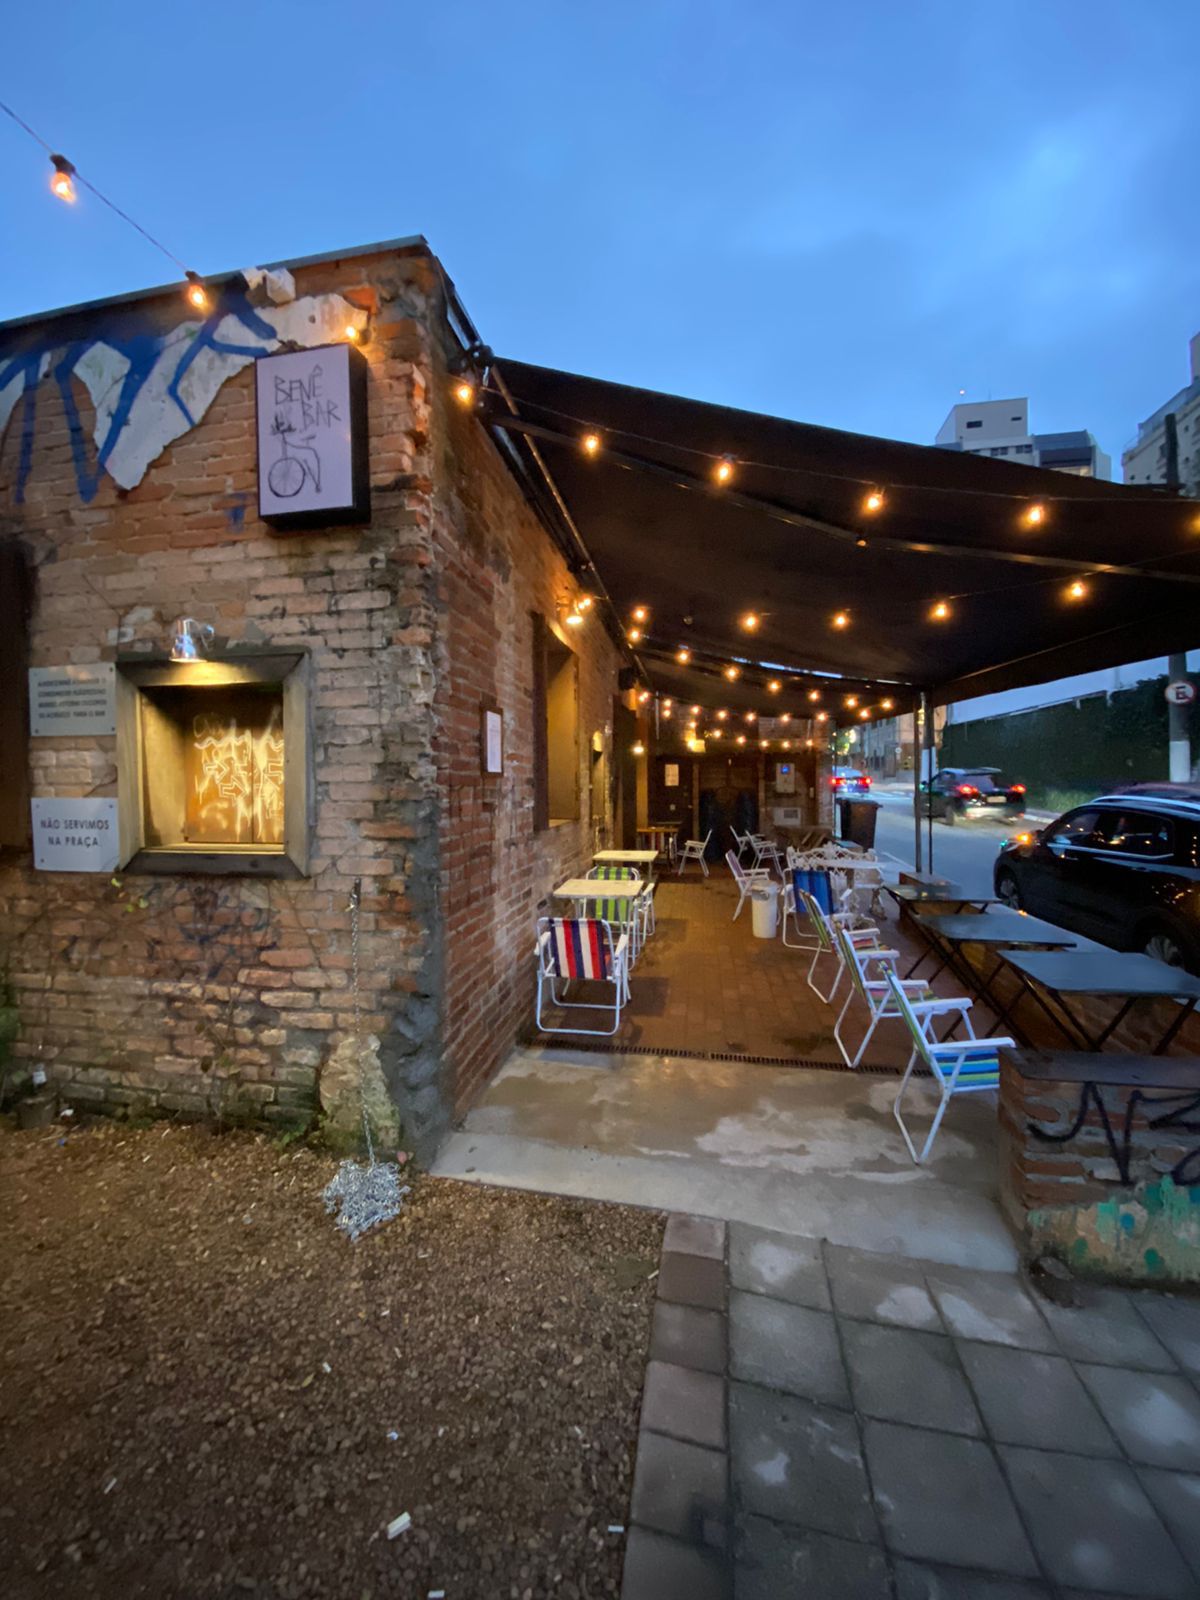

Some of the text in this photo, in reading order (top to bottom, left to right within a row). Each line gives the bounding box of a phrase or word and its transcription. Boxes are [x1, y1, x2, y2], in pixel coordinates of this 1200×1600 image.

[301, 399, 342, 431] BAR
[40, 816, 109, 830] NÃO SERVIMOS
[48, 835, 98, 849] NA PRAÇA
